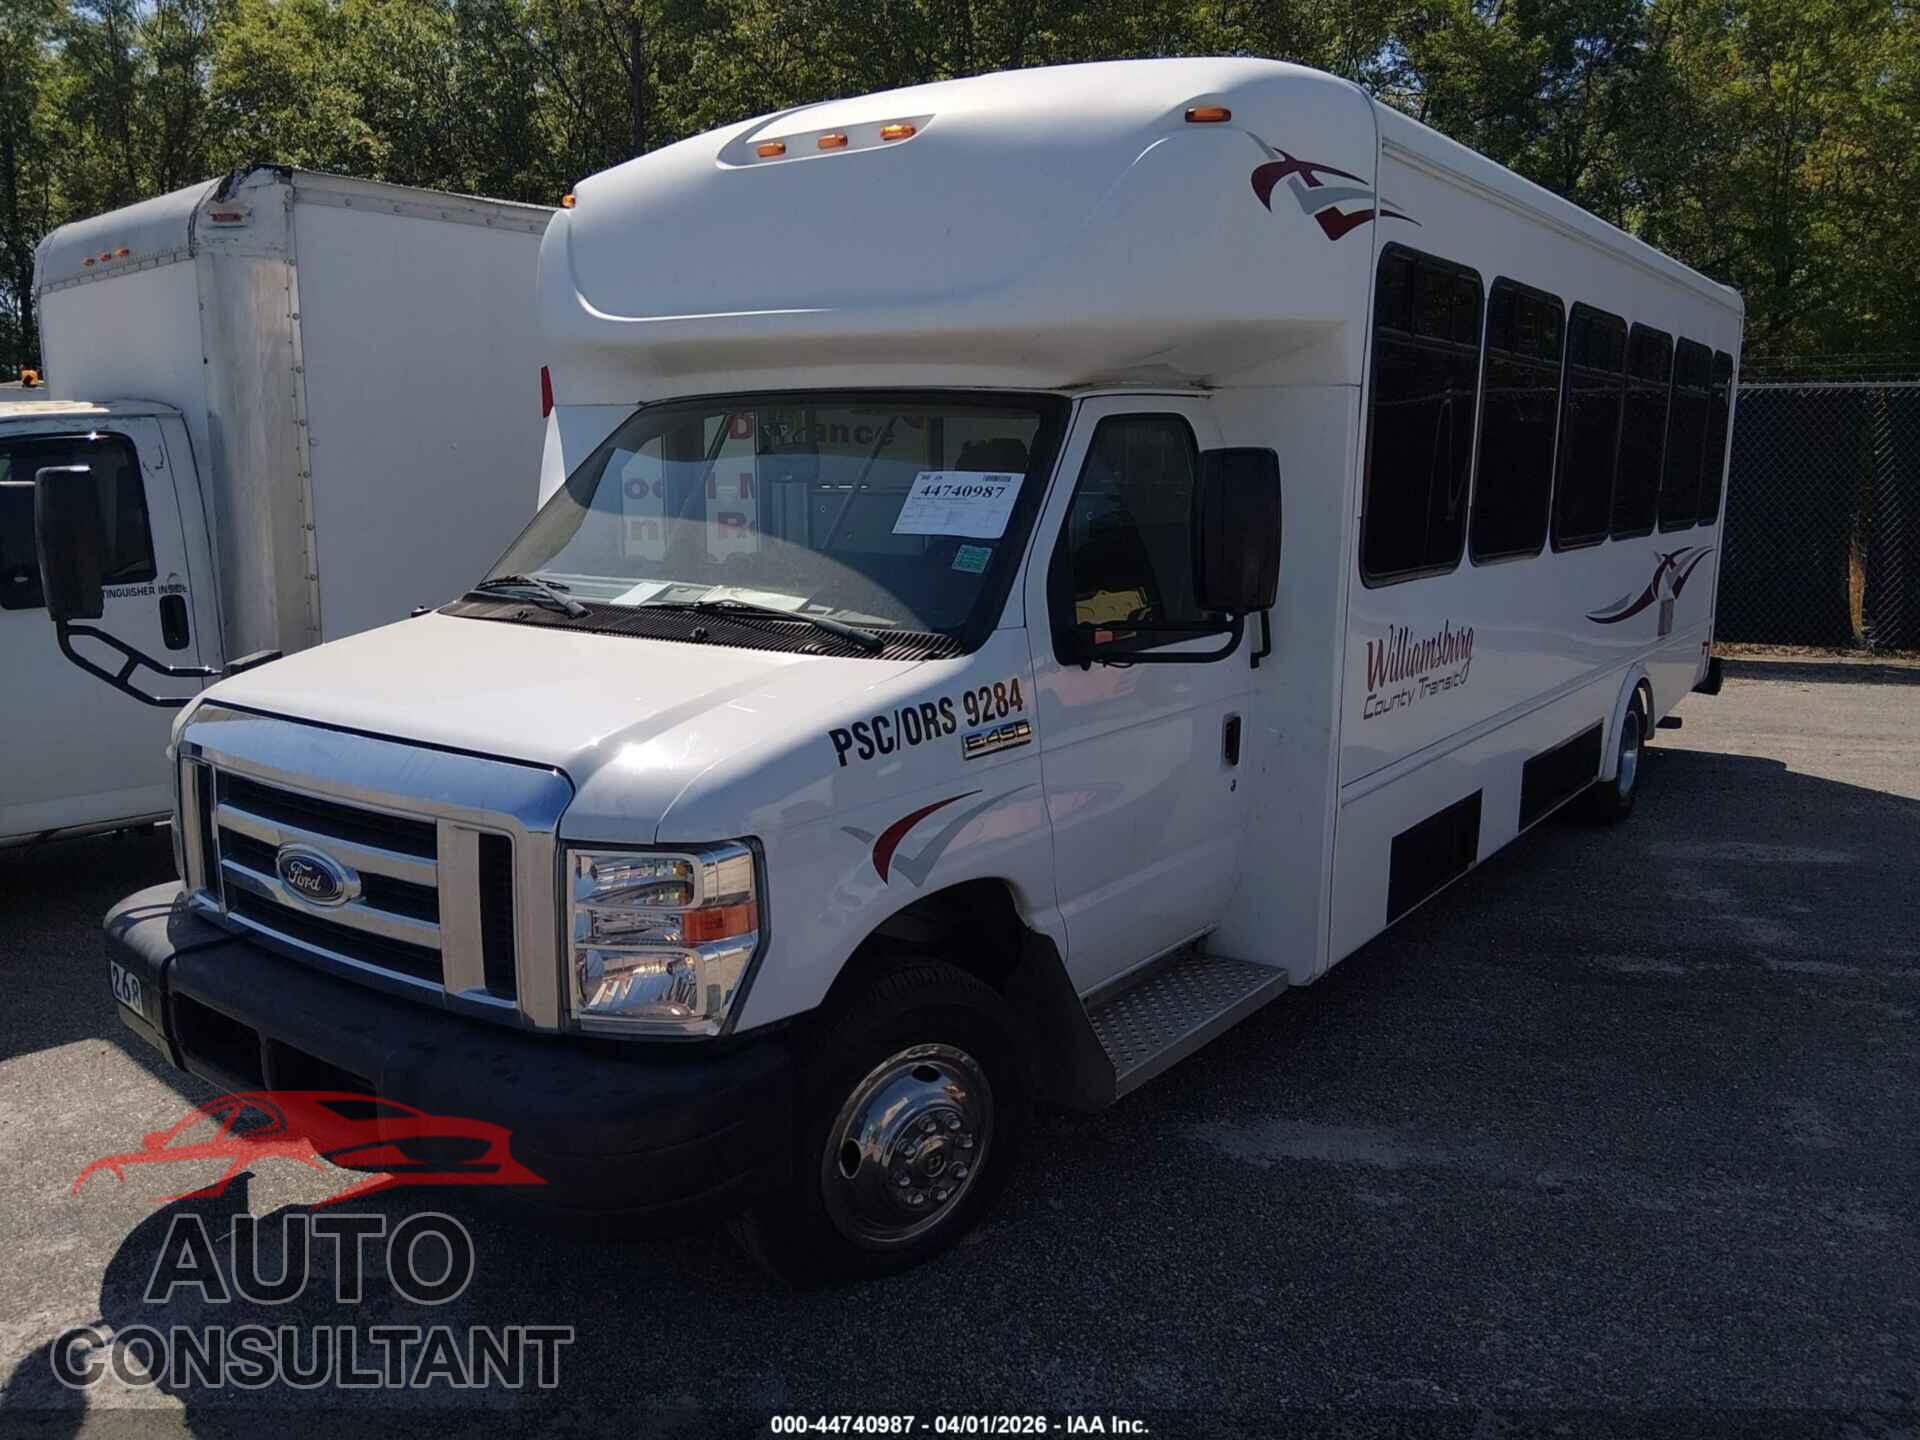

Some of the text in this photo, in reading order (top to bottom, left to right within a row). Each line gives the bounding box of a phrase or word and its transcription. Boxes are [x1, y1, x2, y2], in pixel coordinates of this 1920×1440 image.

[920, 484, 1006, 499] 44740987
[103, 585, 156, 599] TINGUISHER
[1366, 618, 1474, 692] Williamsburg
[1363, 675, 1464, 720] County Transit
[828, 678, 1024, 767] PSC/ORS 9284
[287, 860, 322, 892] Ford
